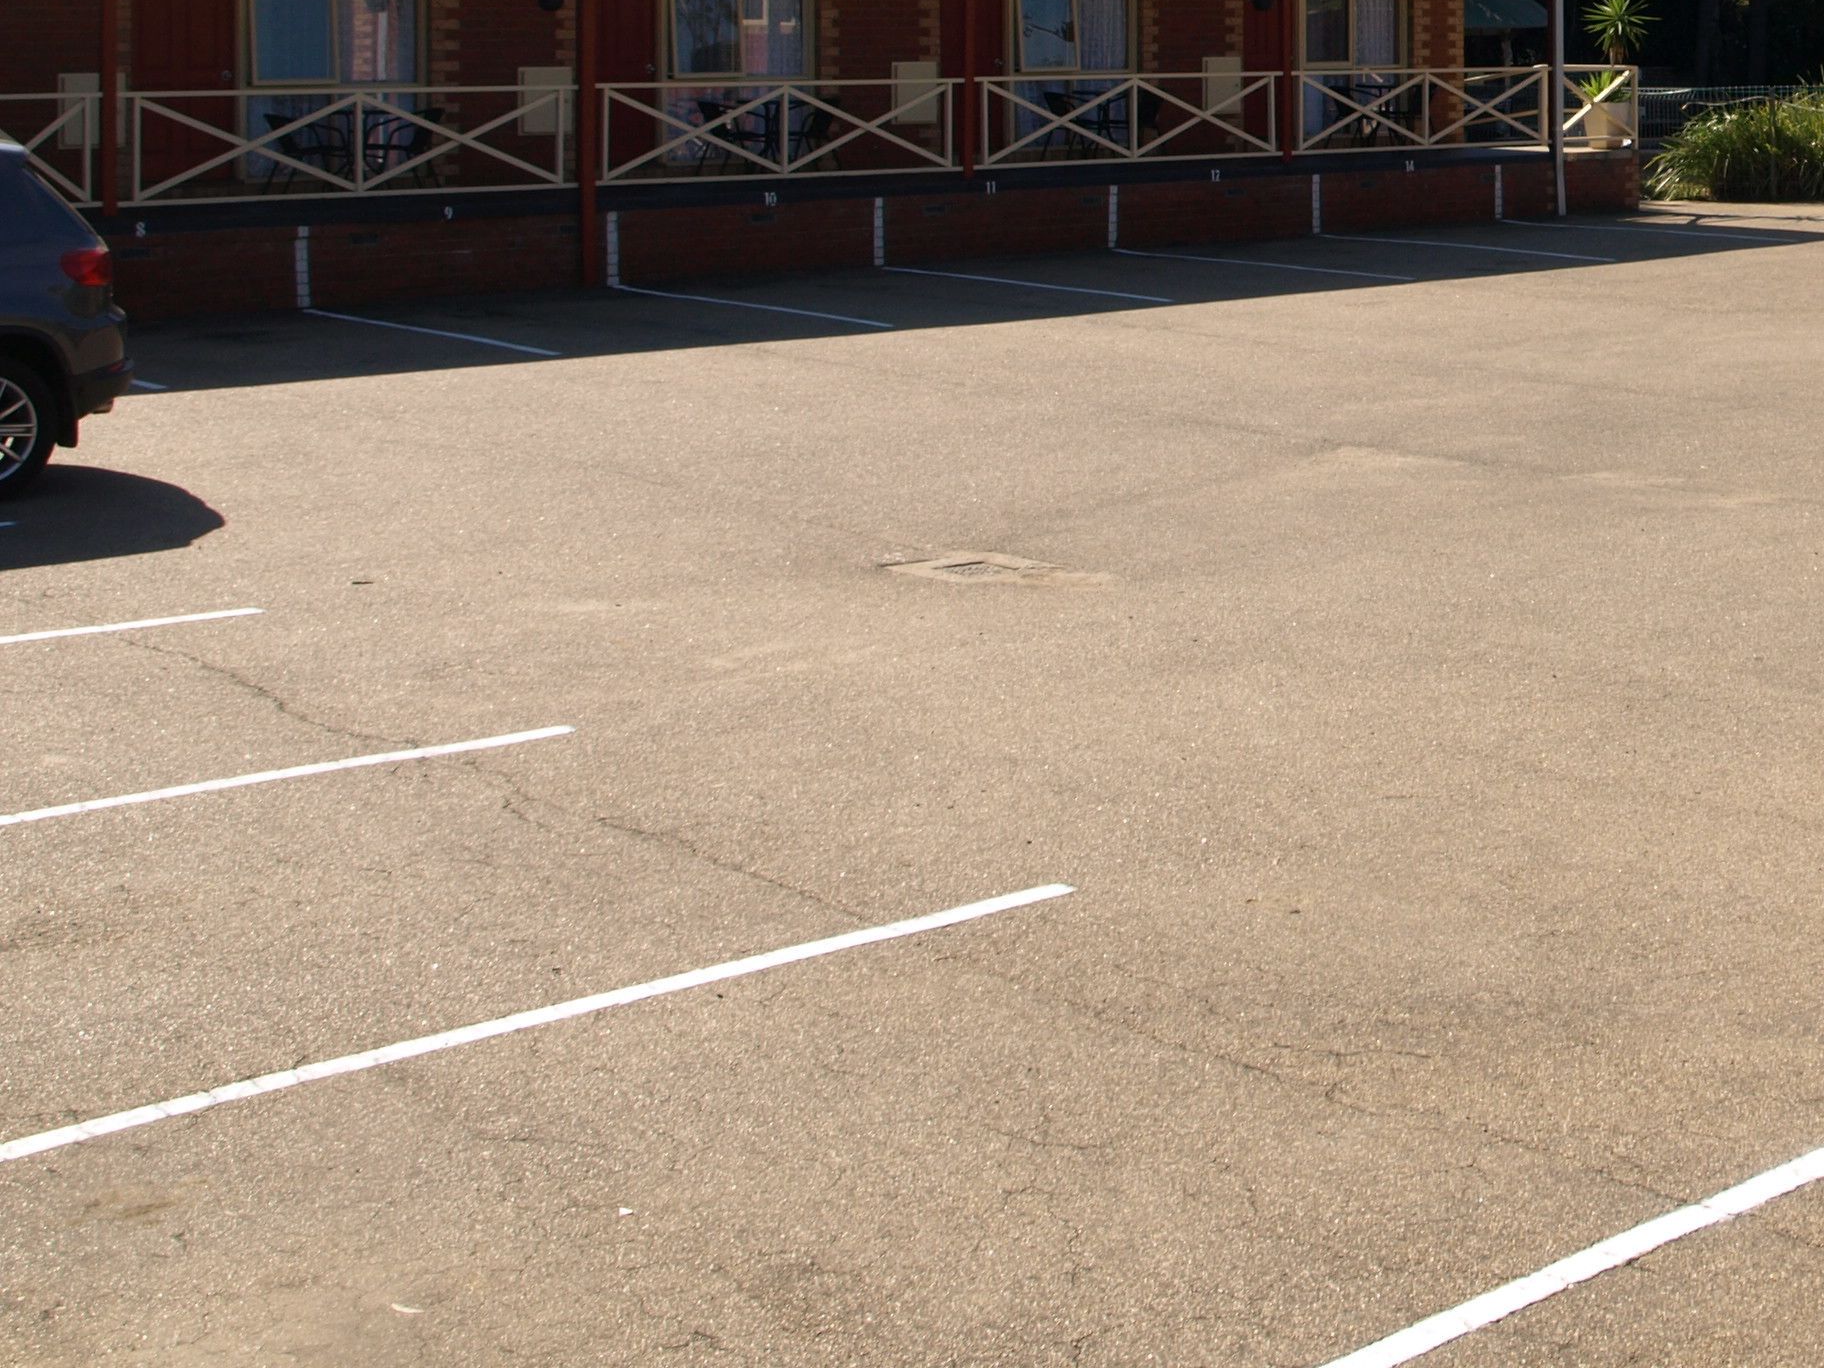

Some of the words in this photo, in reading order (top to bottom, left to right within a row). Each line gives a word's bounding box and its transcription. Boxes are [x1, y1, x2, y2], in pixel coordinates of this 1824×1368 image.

[1405, 160, 1415, 173] 14
[1210, 168, 1221, 183] 12
[986, 180, 996, 195] 11
[764, 191, 778, 207] 10
[444, 206, 454, 220] 9
[136, 221, 146, 238] 8
